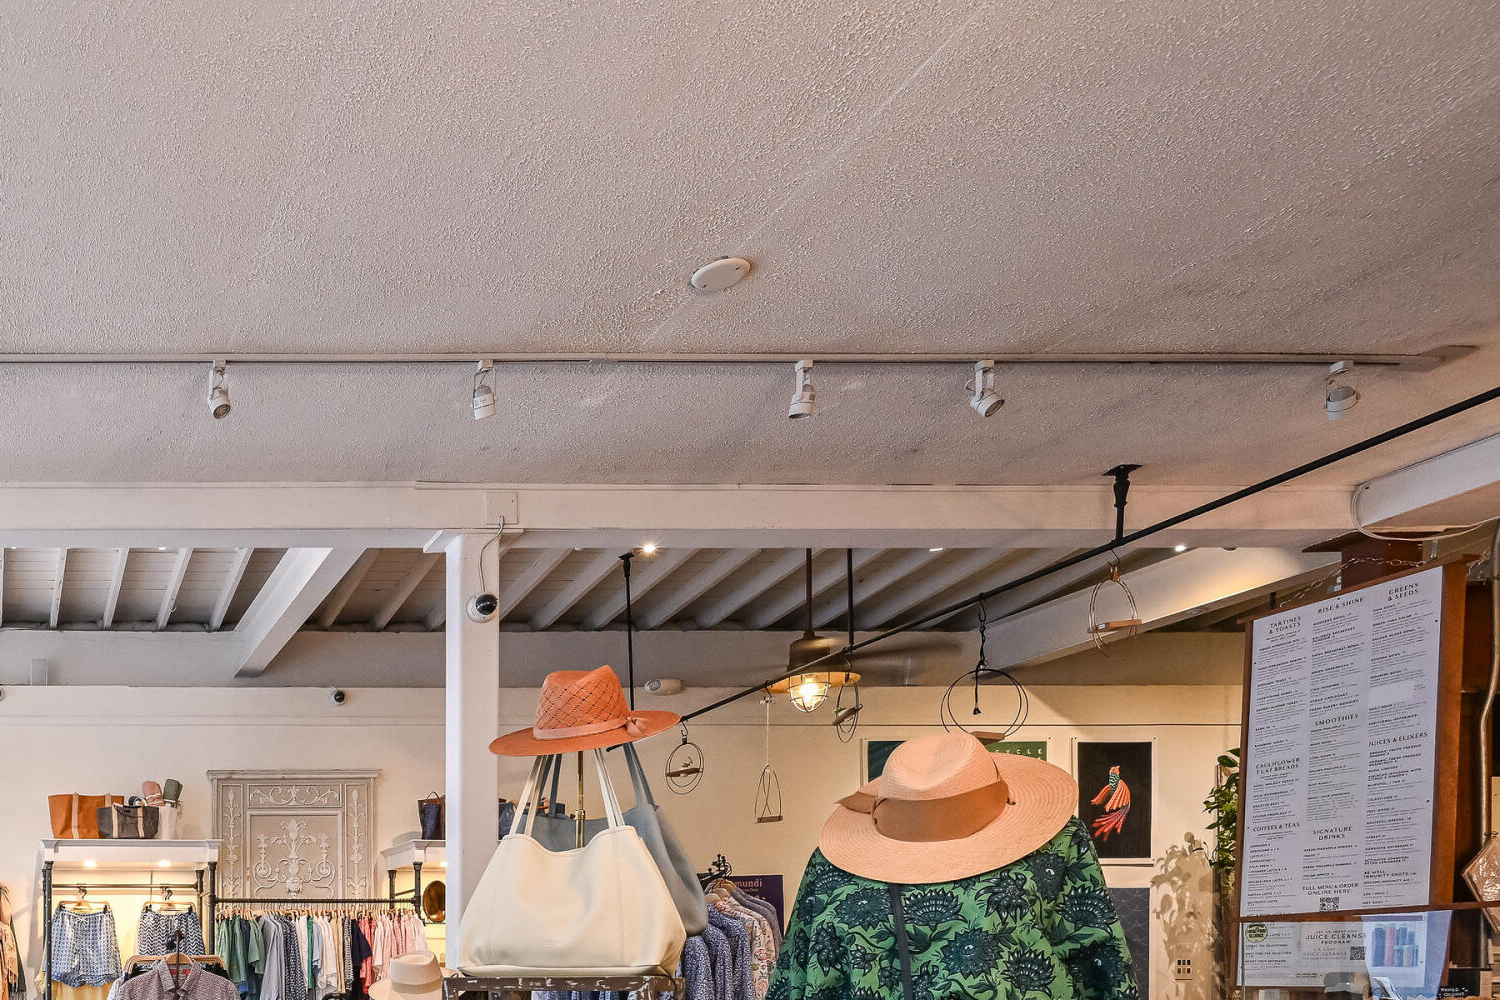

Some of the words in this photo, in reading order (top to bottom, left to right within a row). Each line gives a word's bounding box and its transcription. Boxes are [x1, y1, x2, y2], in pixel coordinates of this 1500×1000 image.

[1388, 583, 1419, 595] GREENS
[1395, 589, 1419, 600] SEEDS
[1318, 604, 1333, 614] RISE
[1342, 597, 1364, 607] SHINE
[1270, 616, 1301, 628] TARTINES
[1276, 622, 1301, 632] TOASTS
[1315, 714, 1358, 727] SMOOTHIES
[1368, 739, 1390, 747] JUICES
[1256, 758, 1300, 769] CAULIFLOWER
[1274, 764, 1299, 772] BREADS
[1252, 824, 1278, 833] COFFEES
[1312, 826, 1353, 835] SIGNATURE
